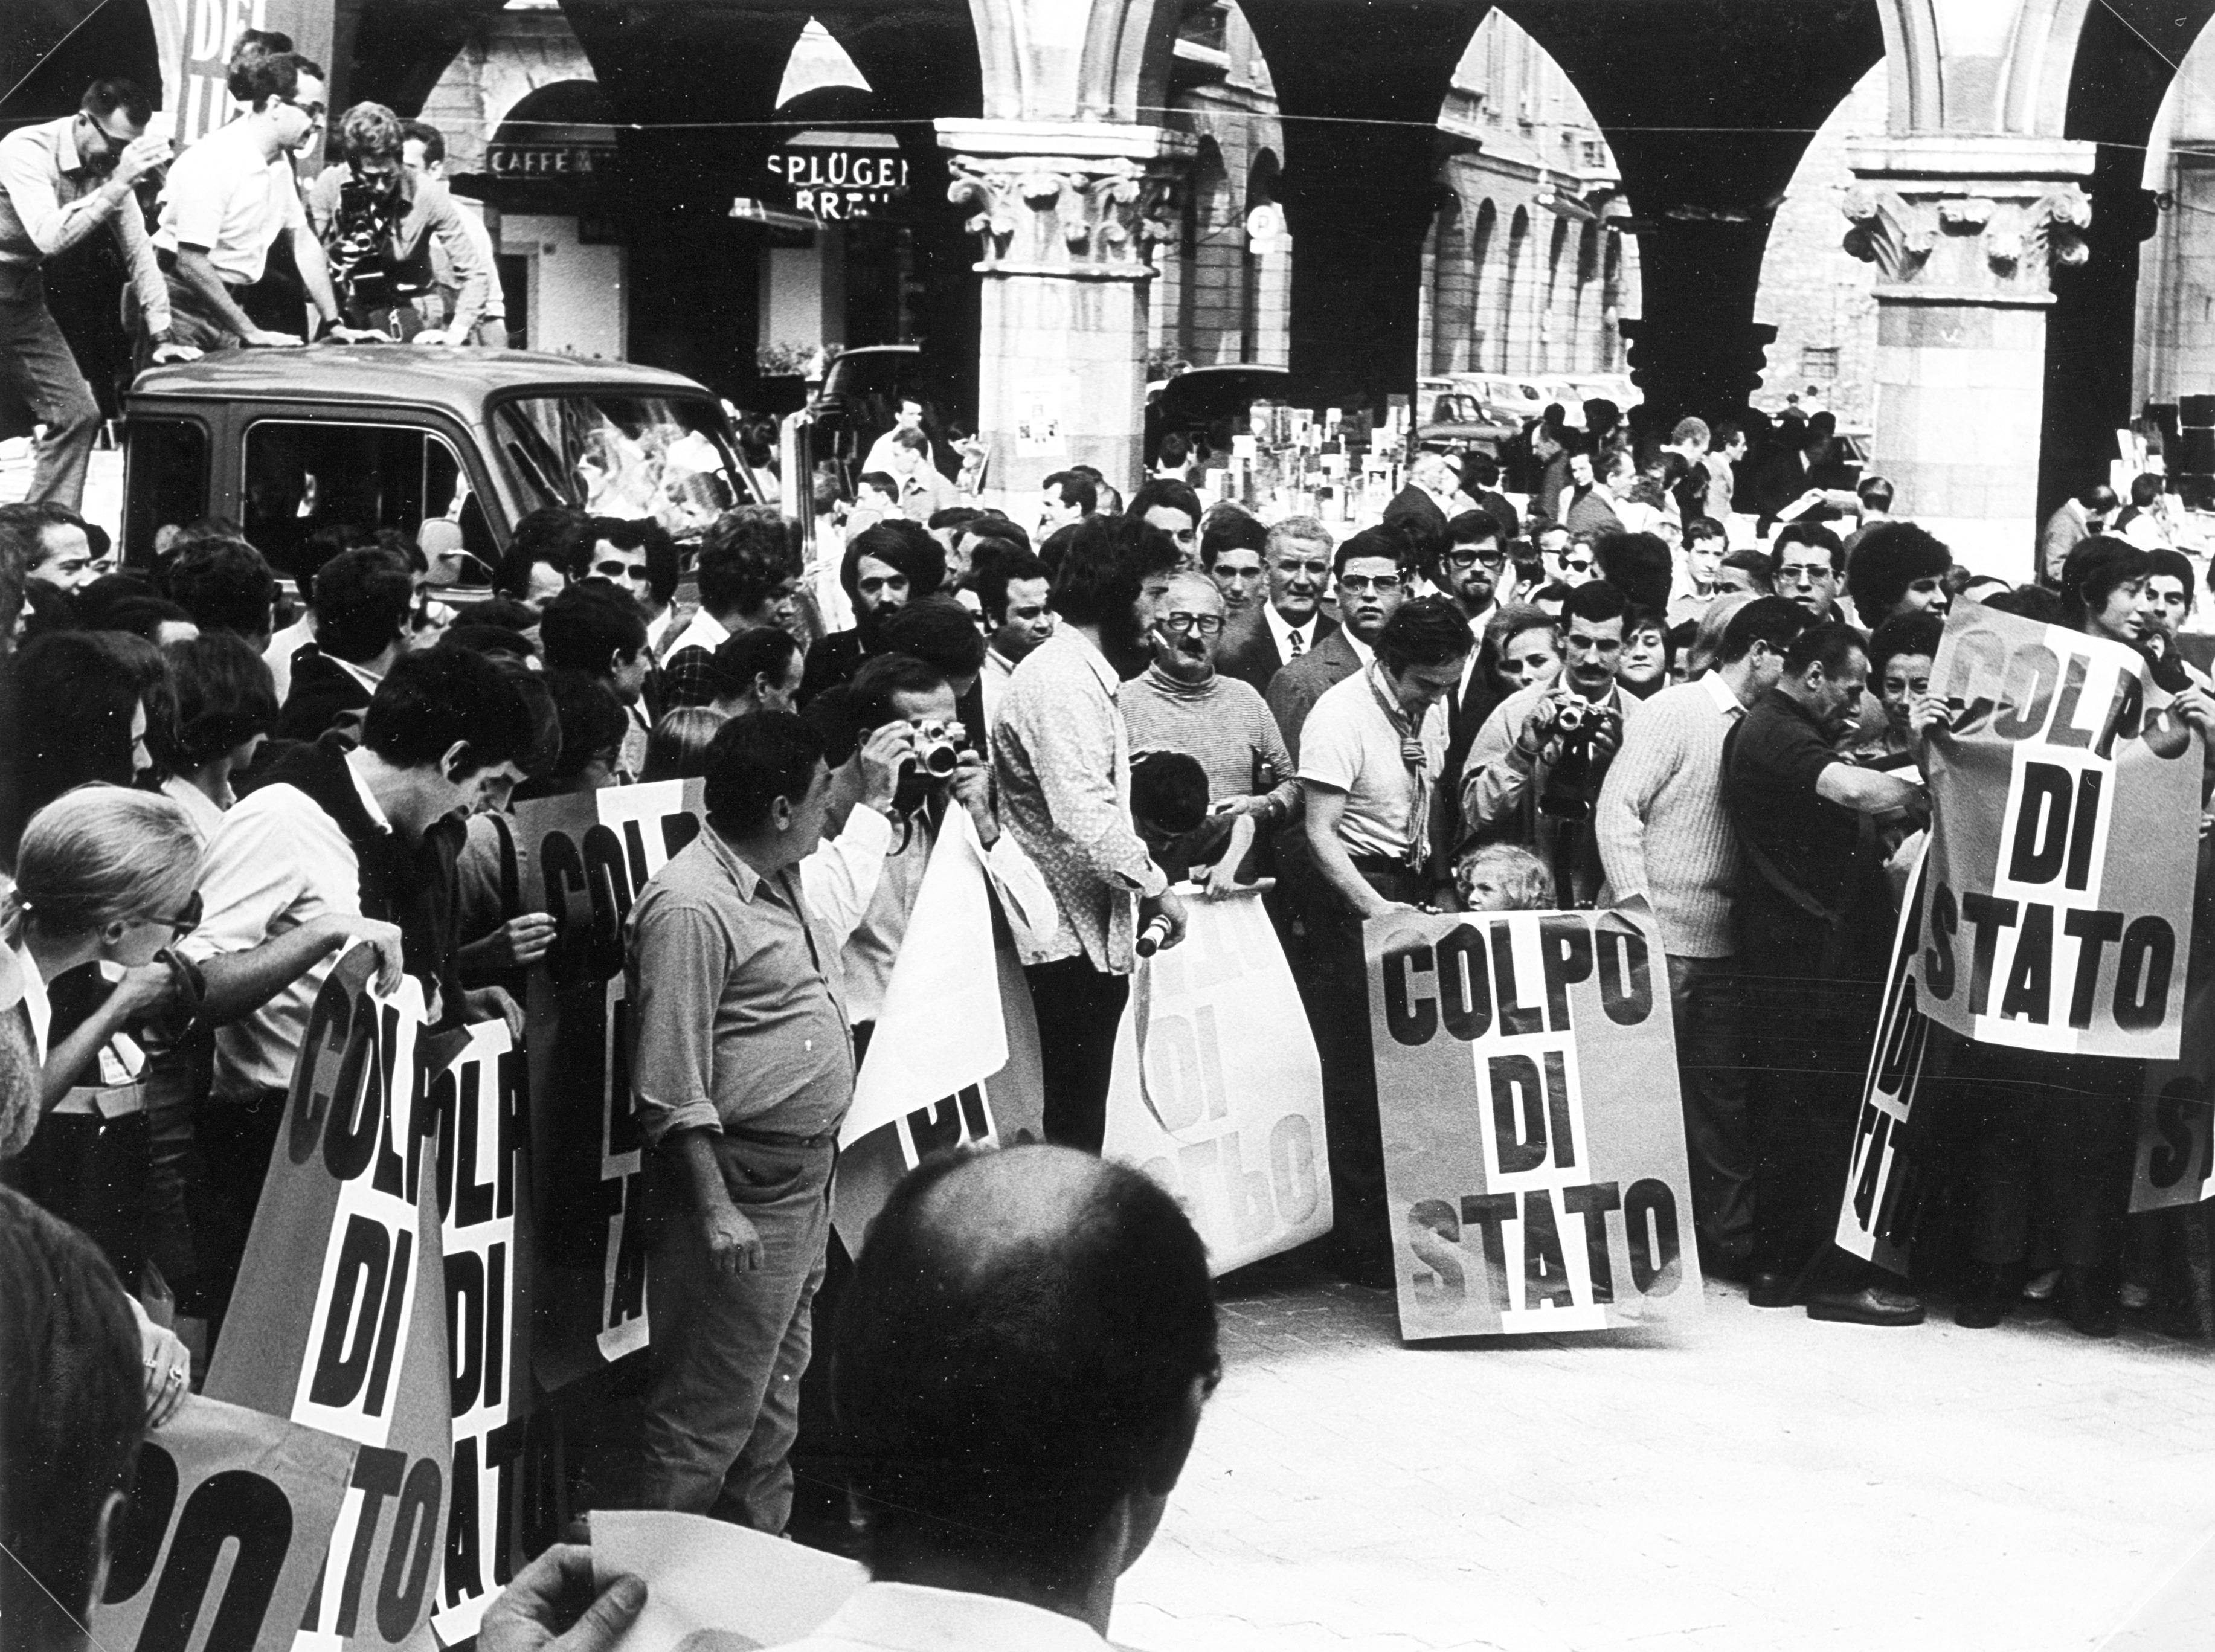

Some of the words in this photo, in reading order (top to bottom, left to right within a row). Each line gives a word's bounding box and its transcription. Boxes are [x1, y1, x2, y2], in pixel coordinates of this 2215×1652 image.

[2008, 761, 2103, 892] DI
[1383, 911, 1653, 1046] COLPO
[1926, 881, 2175, 1035] STATO
[1488, 1050, 1576, 1175] DI
[309, 1213, 413, 1418] DI
[1408, 1178, 1683, 1316] STATO
[443, 1242, 506, 1416] DI
